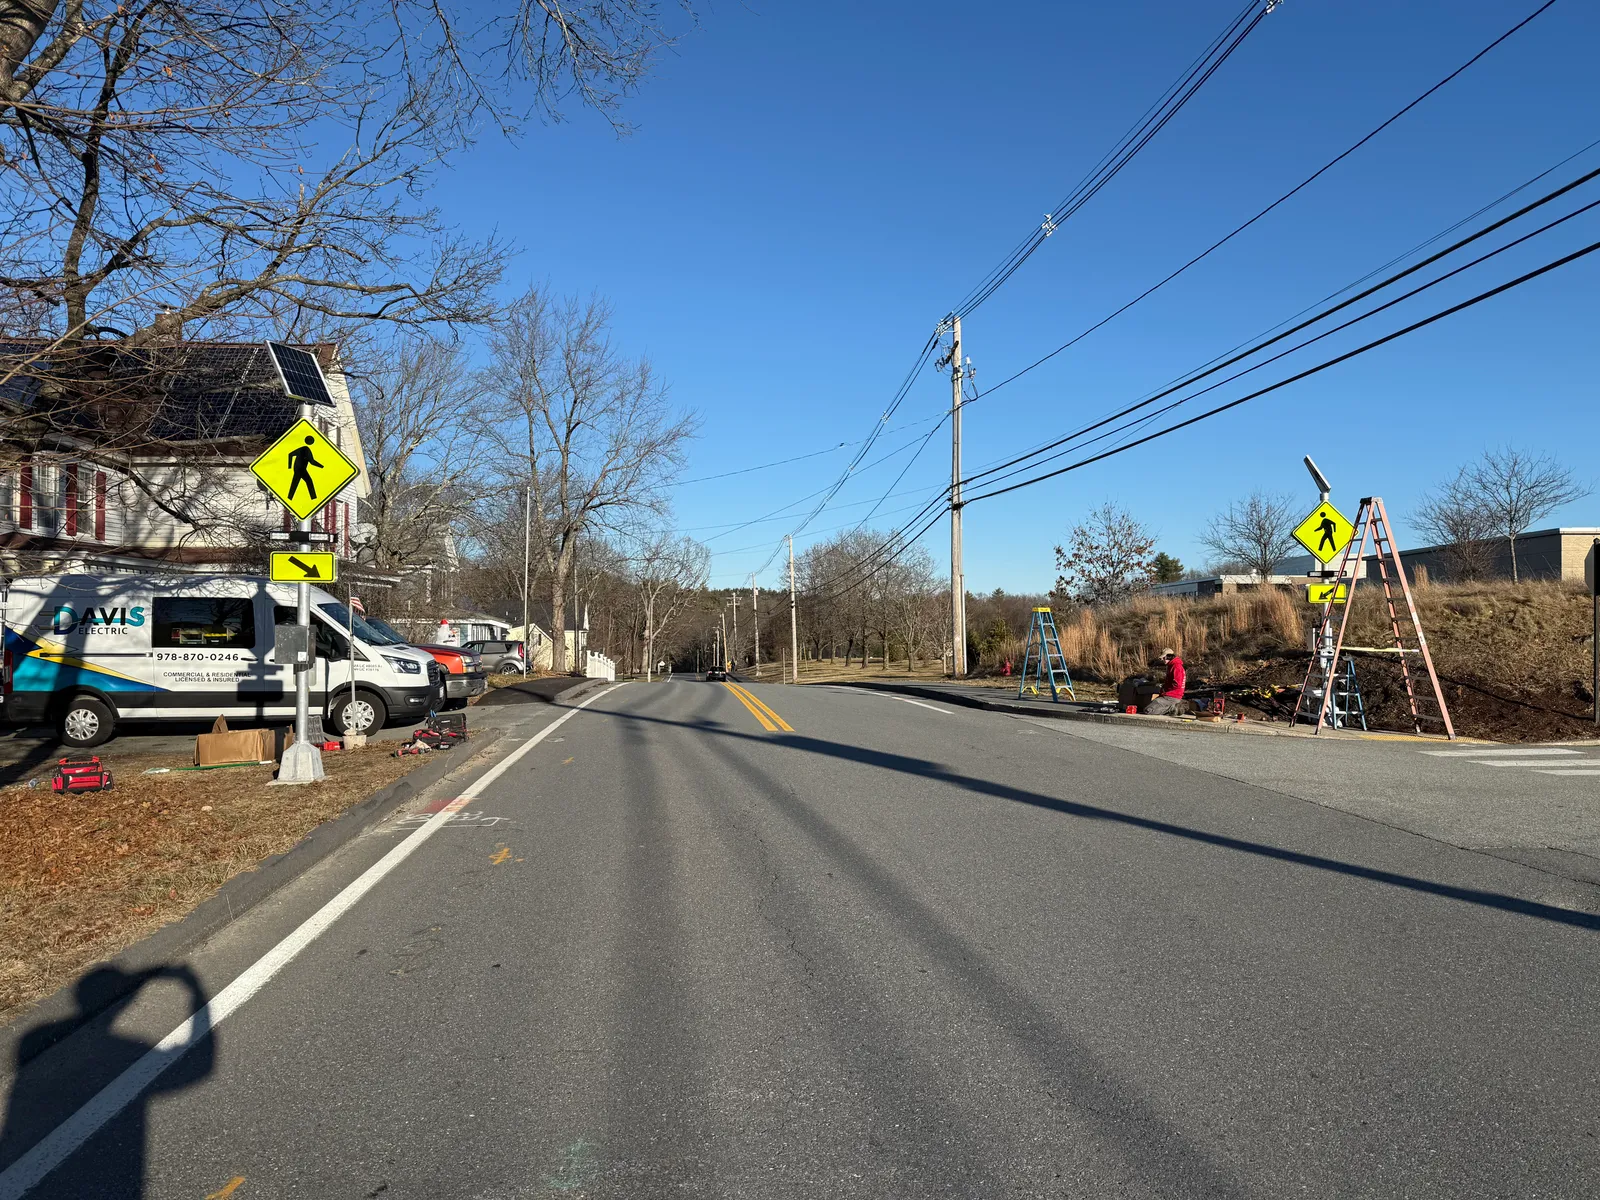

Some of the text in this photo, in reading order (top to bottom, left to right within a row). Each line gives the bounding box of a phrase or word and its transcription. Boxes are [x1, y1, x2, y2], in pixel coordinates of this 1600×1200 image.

[53, 606, 145, 635] DAVIS
[78, 627, 128, 635] ELECTRIC
[156, 653, 239, 661] 978-870-0246
